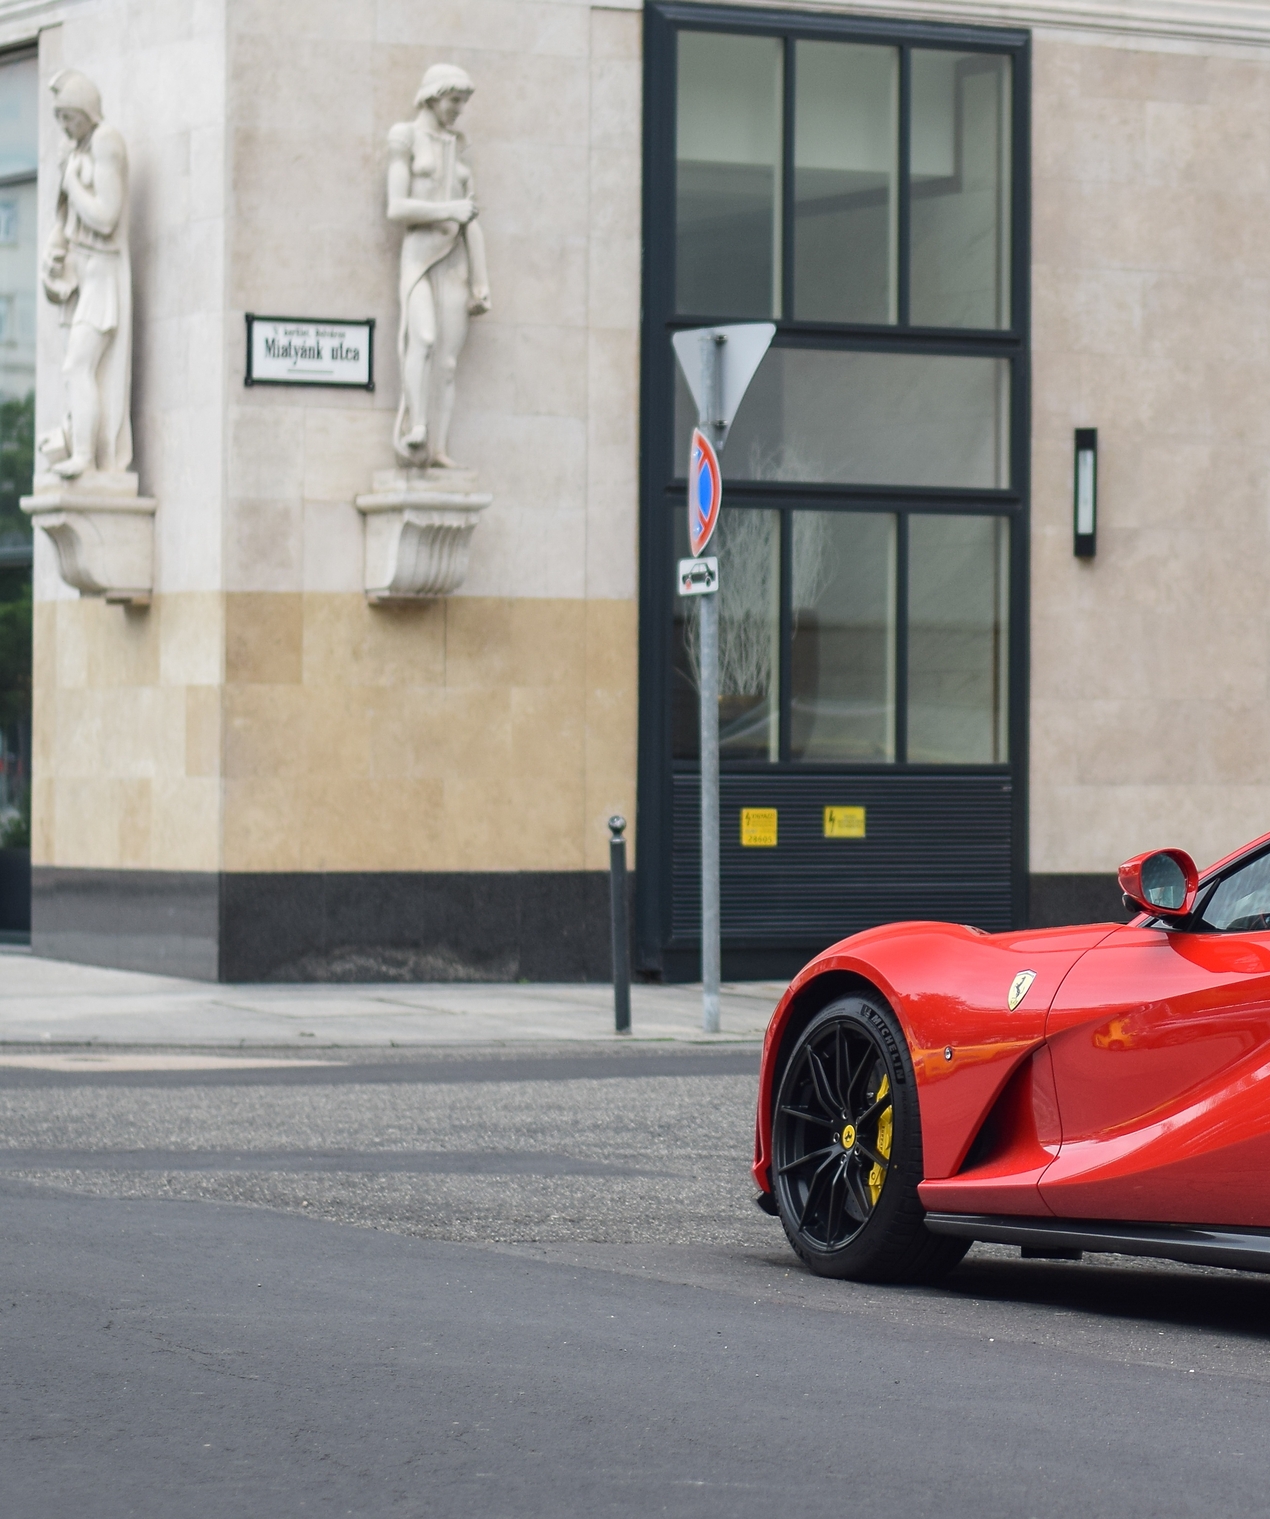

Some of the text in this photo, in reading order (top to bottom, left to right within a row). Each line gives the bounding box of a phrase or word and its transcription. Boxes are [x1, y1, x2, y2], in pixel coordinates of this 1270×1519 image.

[264, 337, 360, 366] Miatyánk utca
[871, 1016, 904, 1081] MICHELIN
